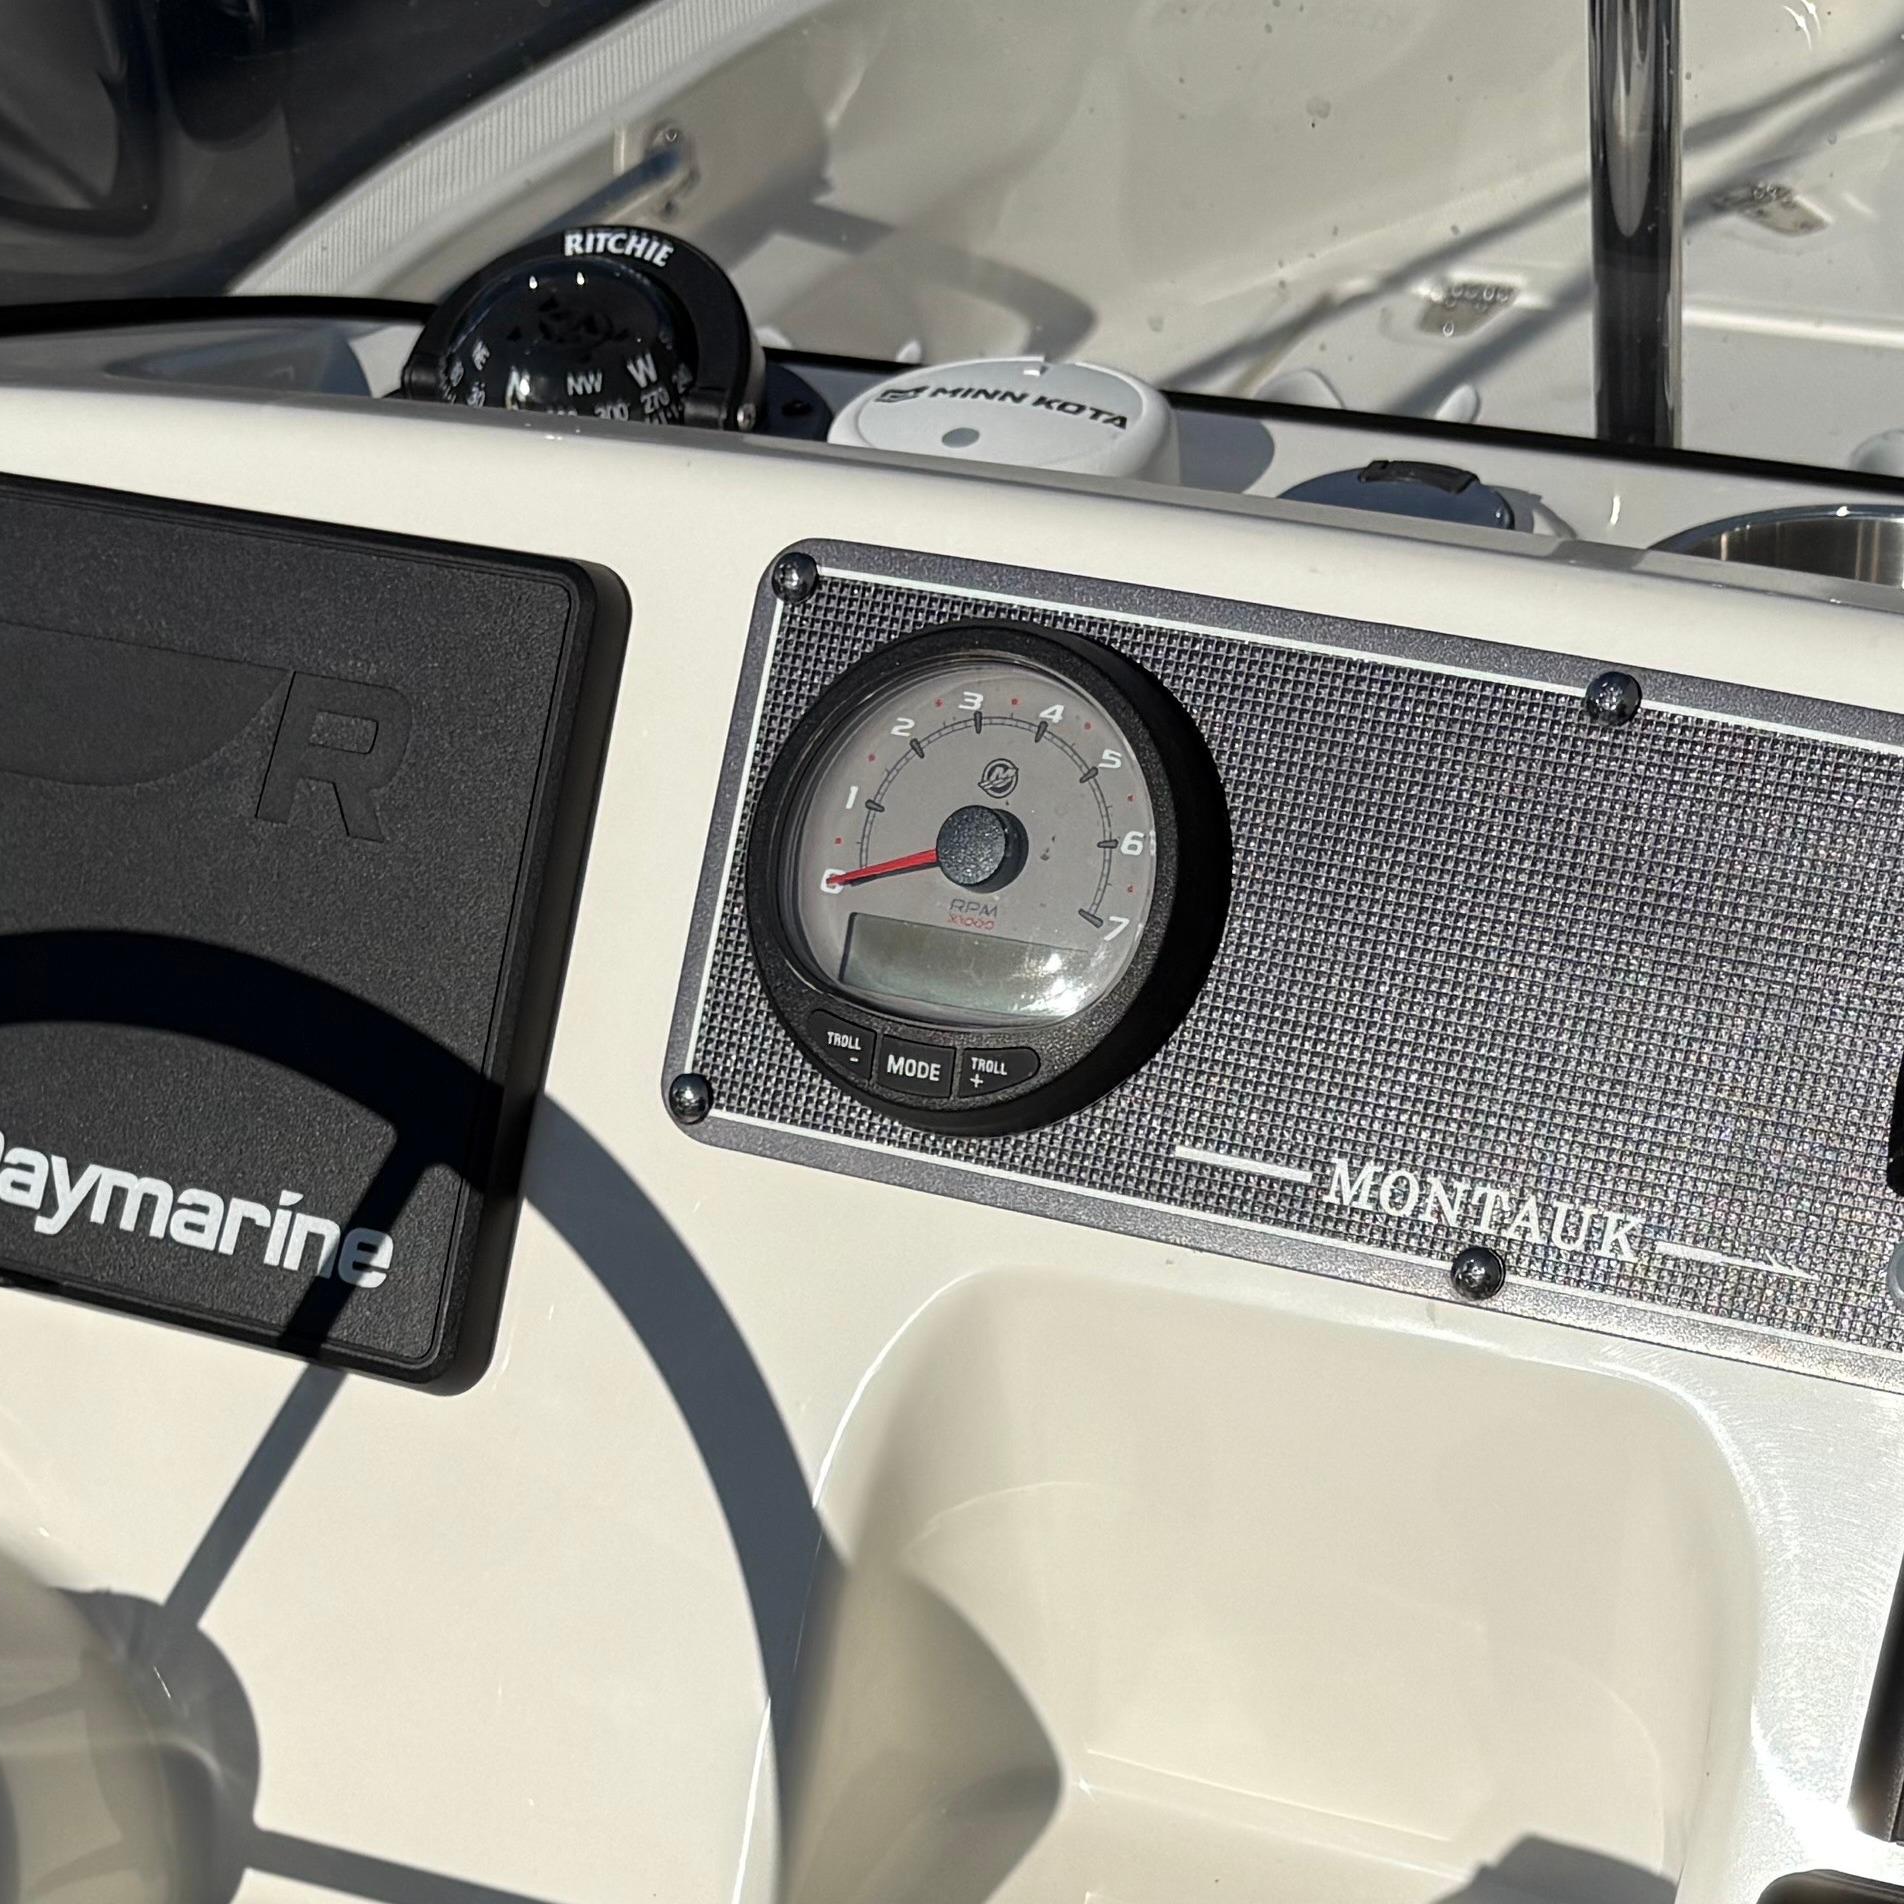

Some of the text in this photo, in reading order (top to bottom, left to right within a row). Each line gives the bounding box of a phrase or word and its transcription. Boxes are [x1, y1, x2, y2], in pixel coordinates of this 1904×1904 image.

[564, 230, 674, 267] RITCHIE
[626, 353, 658, 388] W
[567, 371, 603, 396] NW
[929, 386, 1129, 430] MINN KOTA
[957, 691, 983, 711] 3
[1039, 704, 1065, 723] 4
[890, 717, 916, 737] 2
[1101, 749, 1122, 770] 5
[845, 786, 858, 809] 1
[1120, 832, 1144, 855] 6
[950, 898, 998, 918] RPM
[1104, 916, 1129, 942] 7
[827, 1030, 862, 1052] TROLL
[886, 1054, 942, 1083] MODE
[971, 1056, 1008, 1077] TROLL
[1322, 1157, 1647, 1262] MONTAUK
